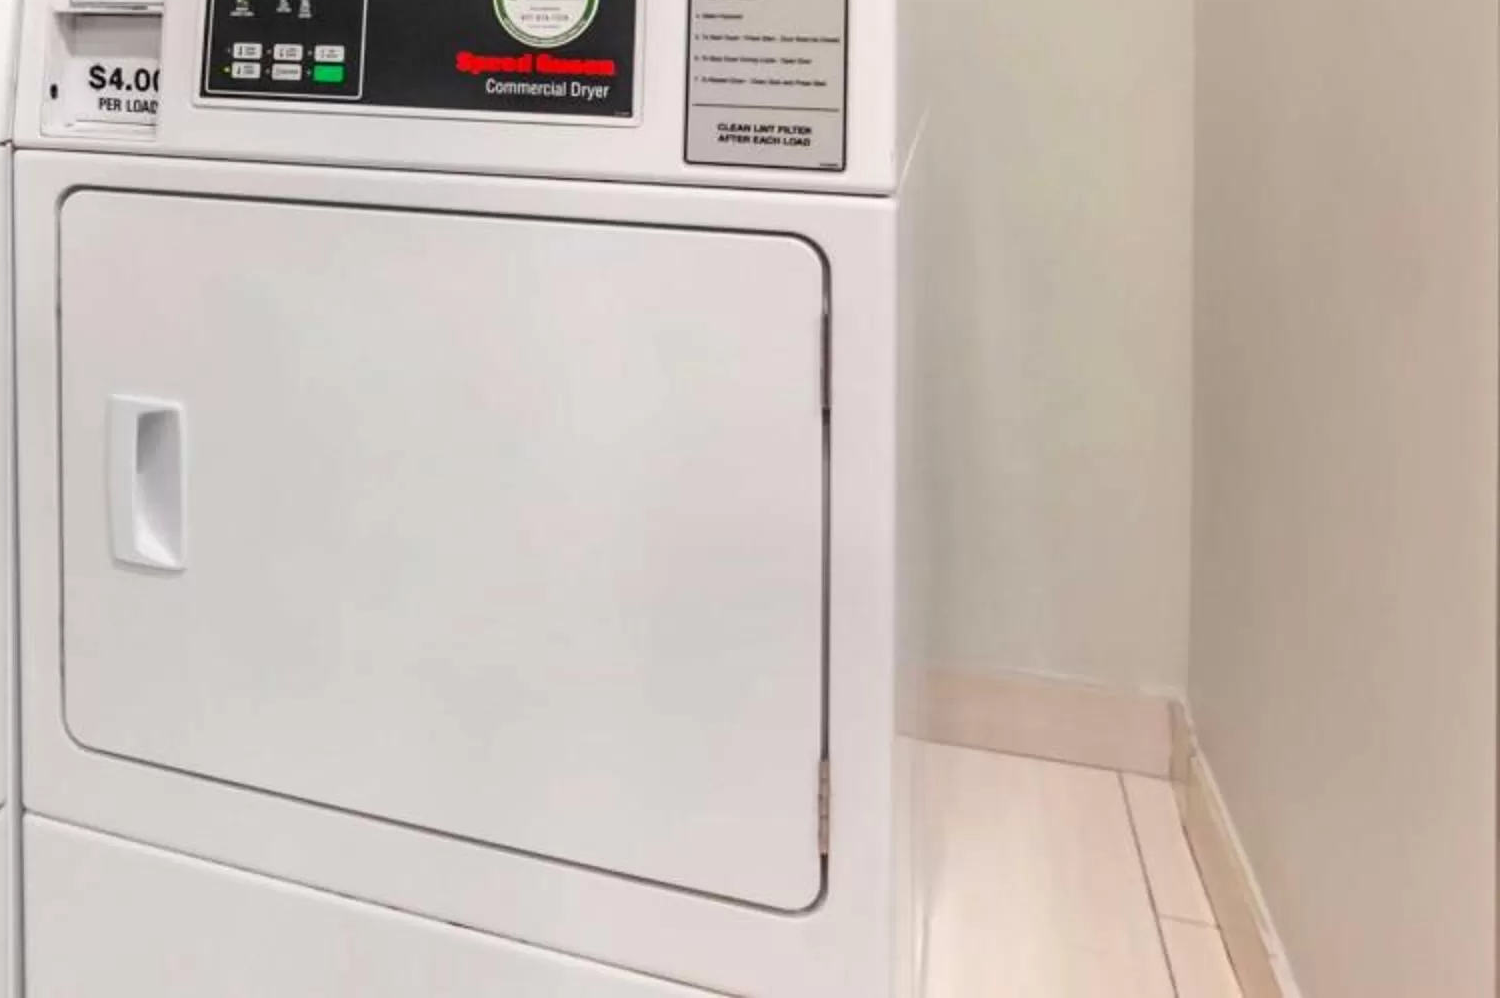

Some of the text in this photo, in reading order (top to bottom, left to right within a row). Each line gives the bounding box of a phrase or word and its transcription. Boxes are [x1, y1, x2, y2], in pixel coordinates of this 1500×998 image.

[485, 78, 610, 101] Commercial Dryer
[98, 97, 159, 115] PER LOAD
[717, 123, 812, 135] CLEAN LINT FILTER
[717, 134, 811, 147] AFTER EACH LOAD
